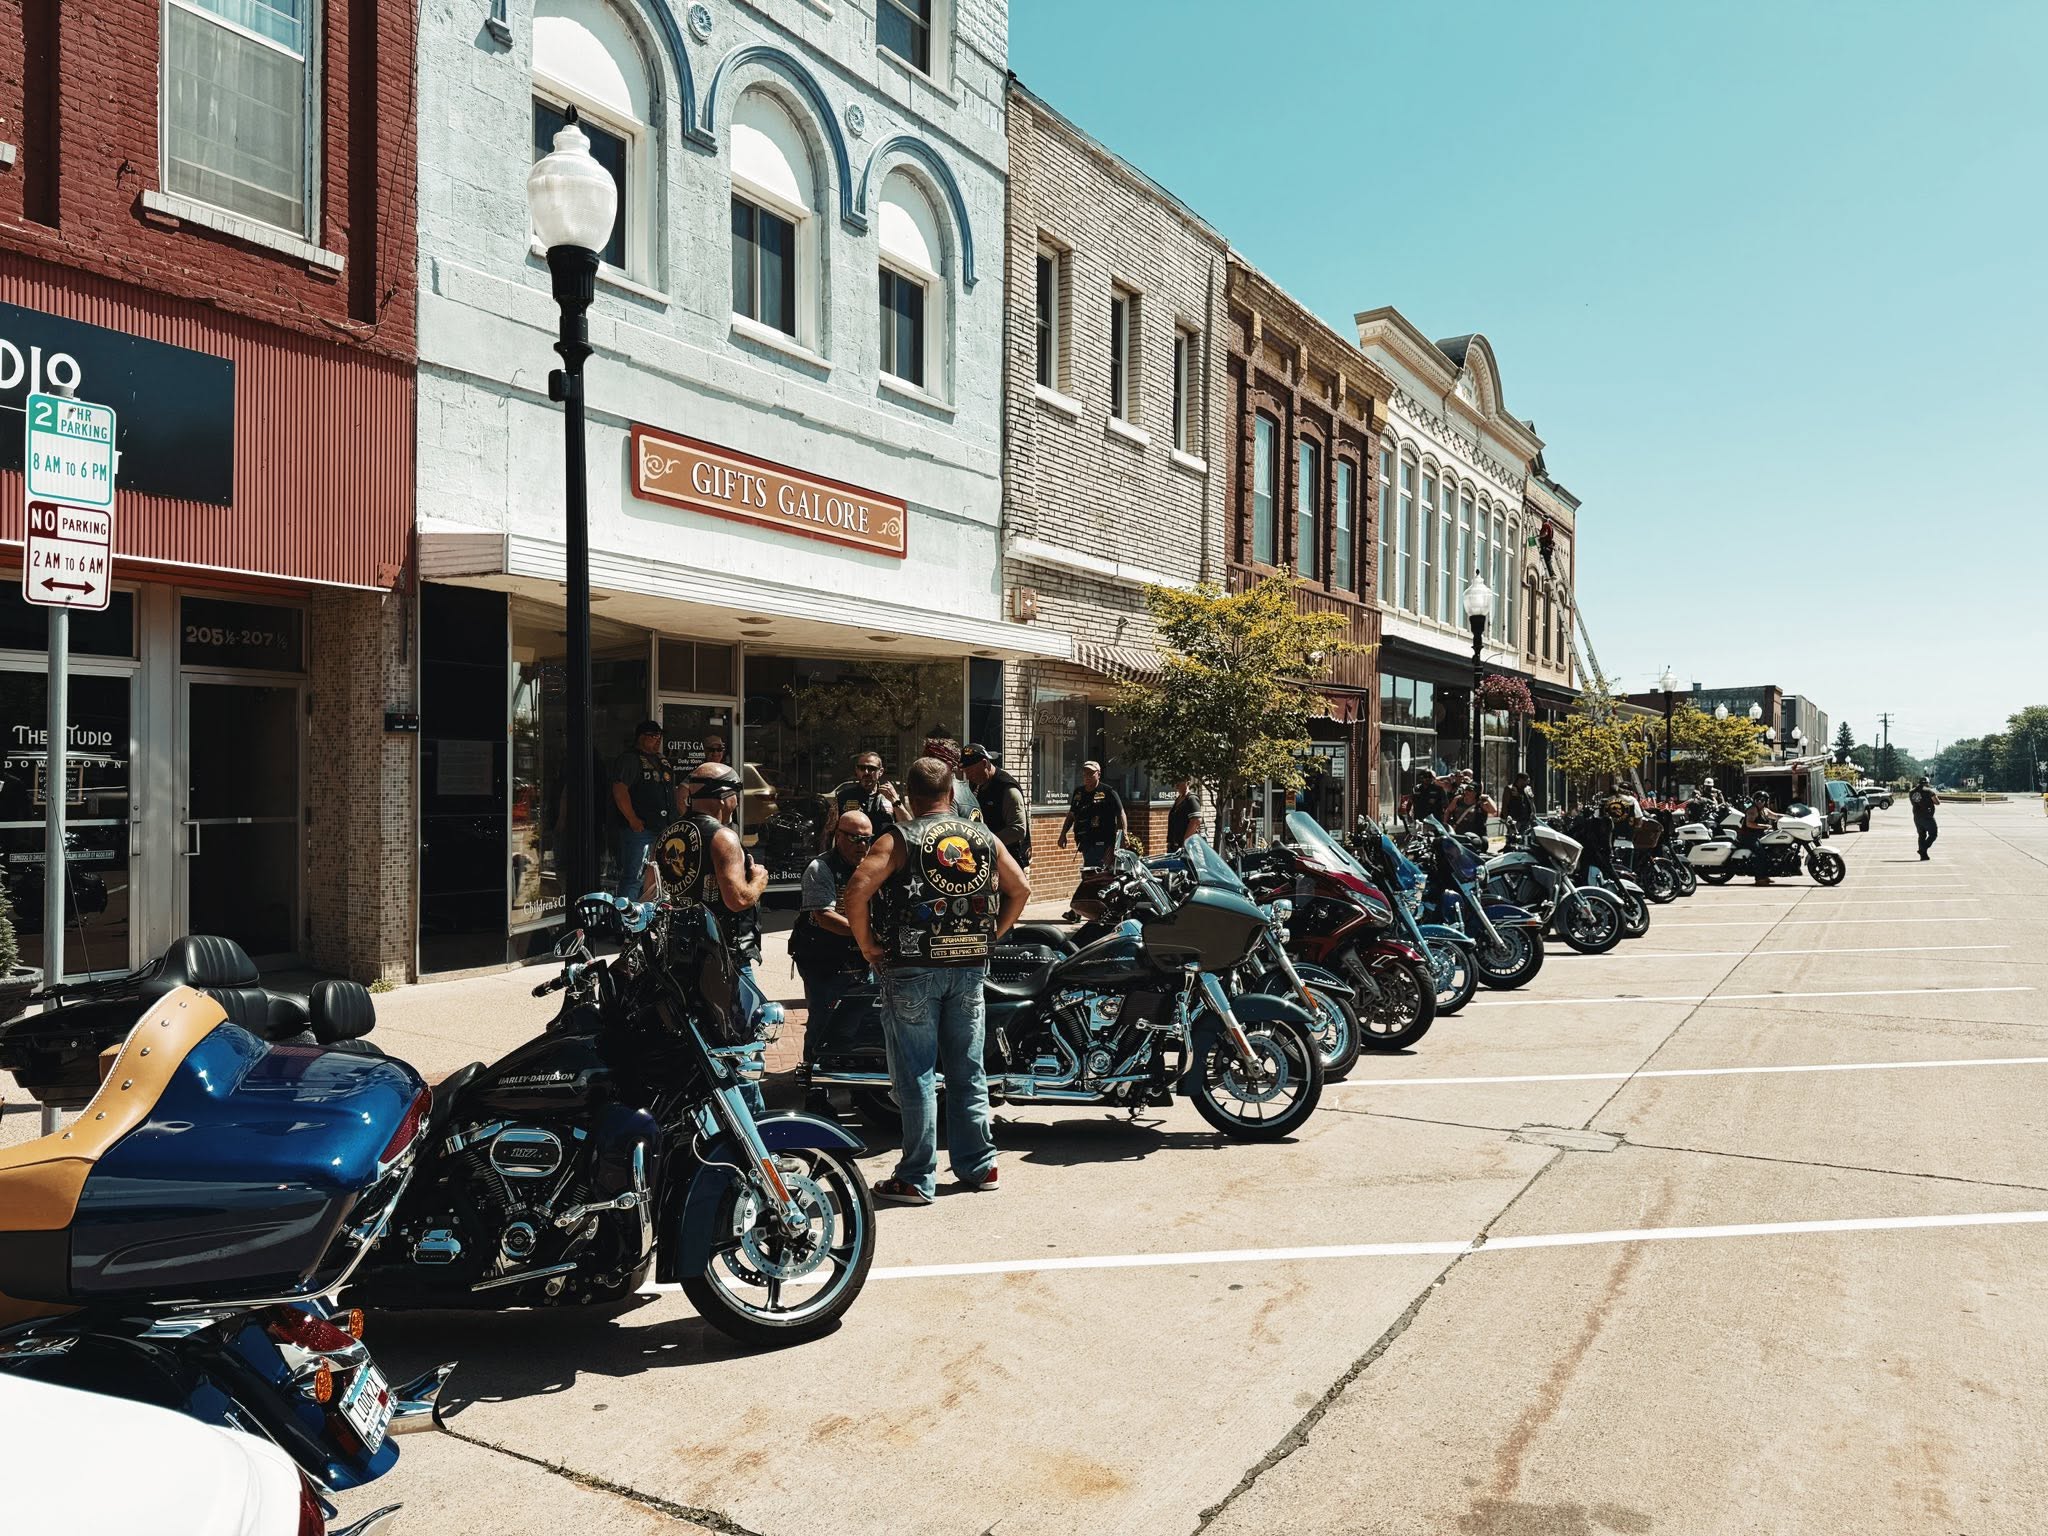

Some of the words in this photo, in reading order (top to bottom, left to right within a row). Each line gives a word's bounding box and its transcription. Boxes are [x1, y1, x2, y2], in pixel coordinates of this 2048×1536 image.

[35, 402, 53, 427] 2
[77, 408, 92, 422] HR
[61, 419, 108, 439] PARKING
[33, 453, 40, 470] 8
[44, 455, 61, 474] AM
[66, 462, 76, 476] TO
[81, 461, 87, 478] 6
[92, 463, 107, 481] PM
[691, 461, 768, 509] GIFTS
[777, 484, 870, 535] GALORE
[31, 508, 56, 531] NO
[62, 518, 107, 536] PARKING
[33, 550, 41, 567] 2
[44, 551, 61, 569] AM
[65, 558, 75, 571] TO
[79, 556, 85, 572] 6
[89, 557, 104, 574] AM
[667, 740, 691, 751] GIFTS
[4, 760, 122, 769] DOWTOWN
[657, 823, 691, 849] COMBAT
[688, 829, 699, 852] VETS
[924, 822, 957, 853] COMBAT
[961, 824, 983, 846] VETS
[928, 861, 989, 893] ASSOCIATION
[523, 897, 558, 915] Children's
[941, 936, 978, 944] AFGHANISTAN
[949, 948, 972, 956] HELPING
